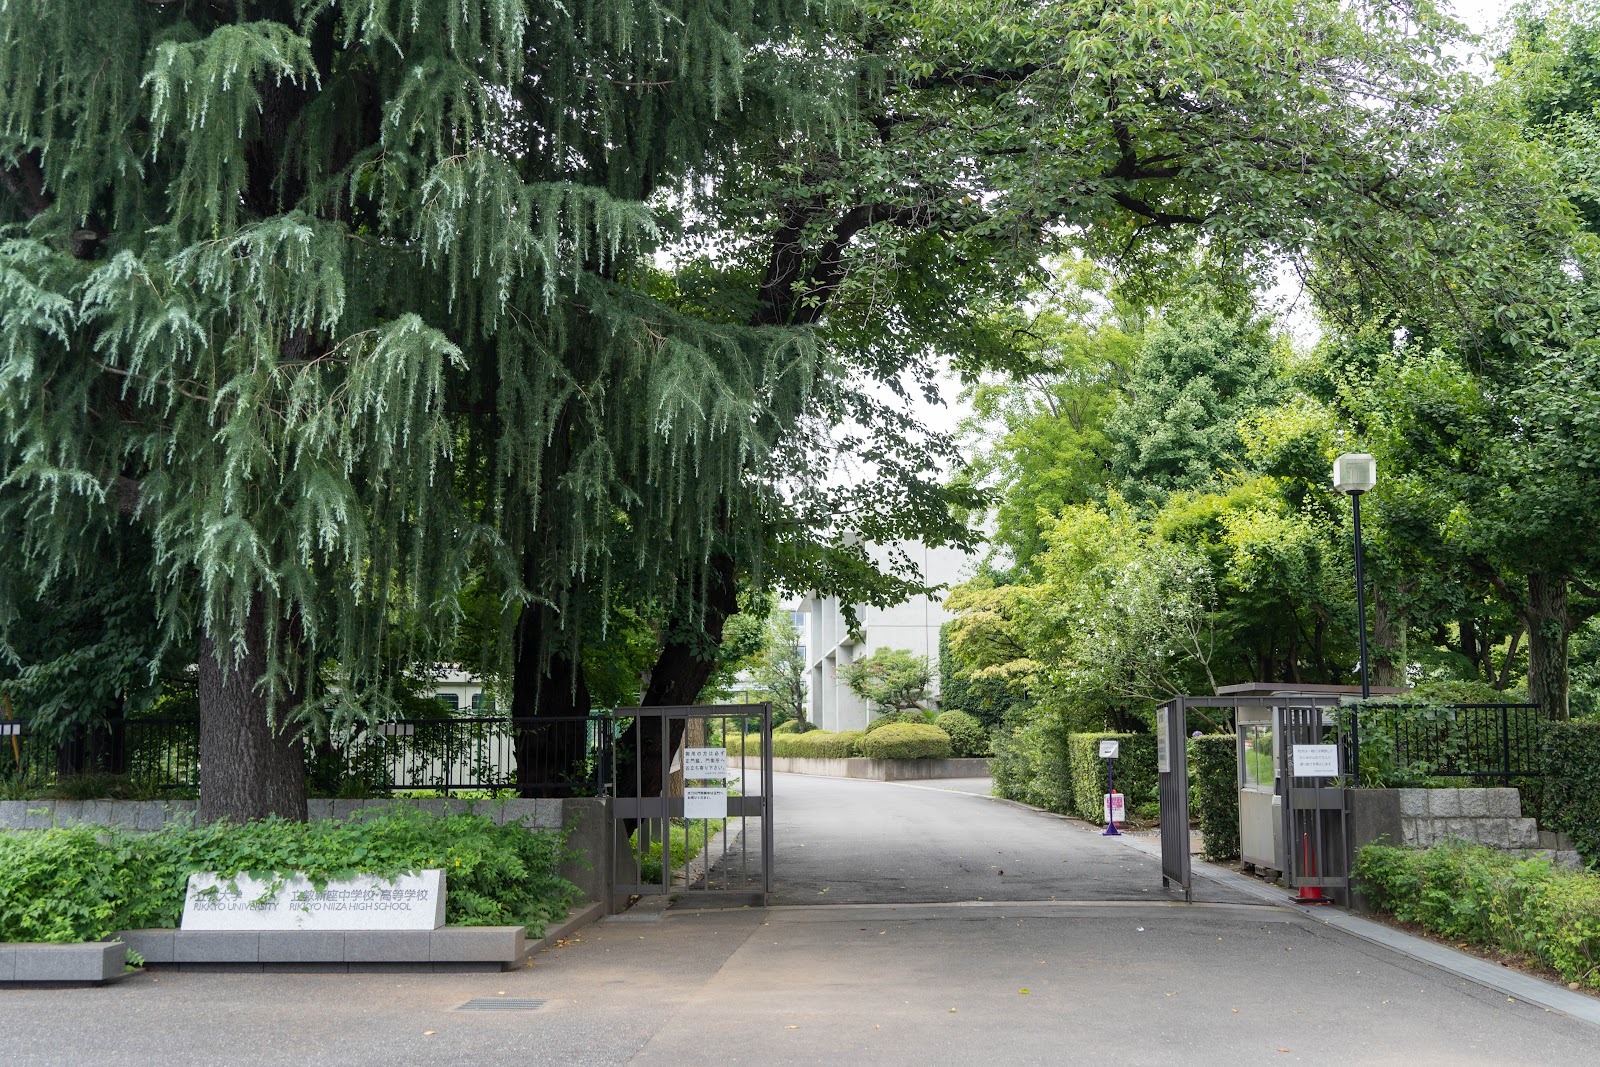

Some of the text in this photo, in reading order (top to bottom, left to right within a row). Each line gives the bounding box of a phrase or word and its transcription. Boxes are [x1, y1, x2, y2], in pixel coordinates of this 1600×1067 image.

[193, 902, 226, 911] RIKKYO
[323, 902, 348, 911] NIIZA
[348, 902, 373, 911] HIGH
[373, 902, 412, 911] SCHOOL
